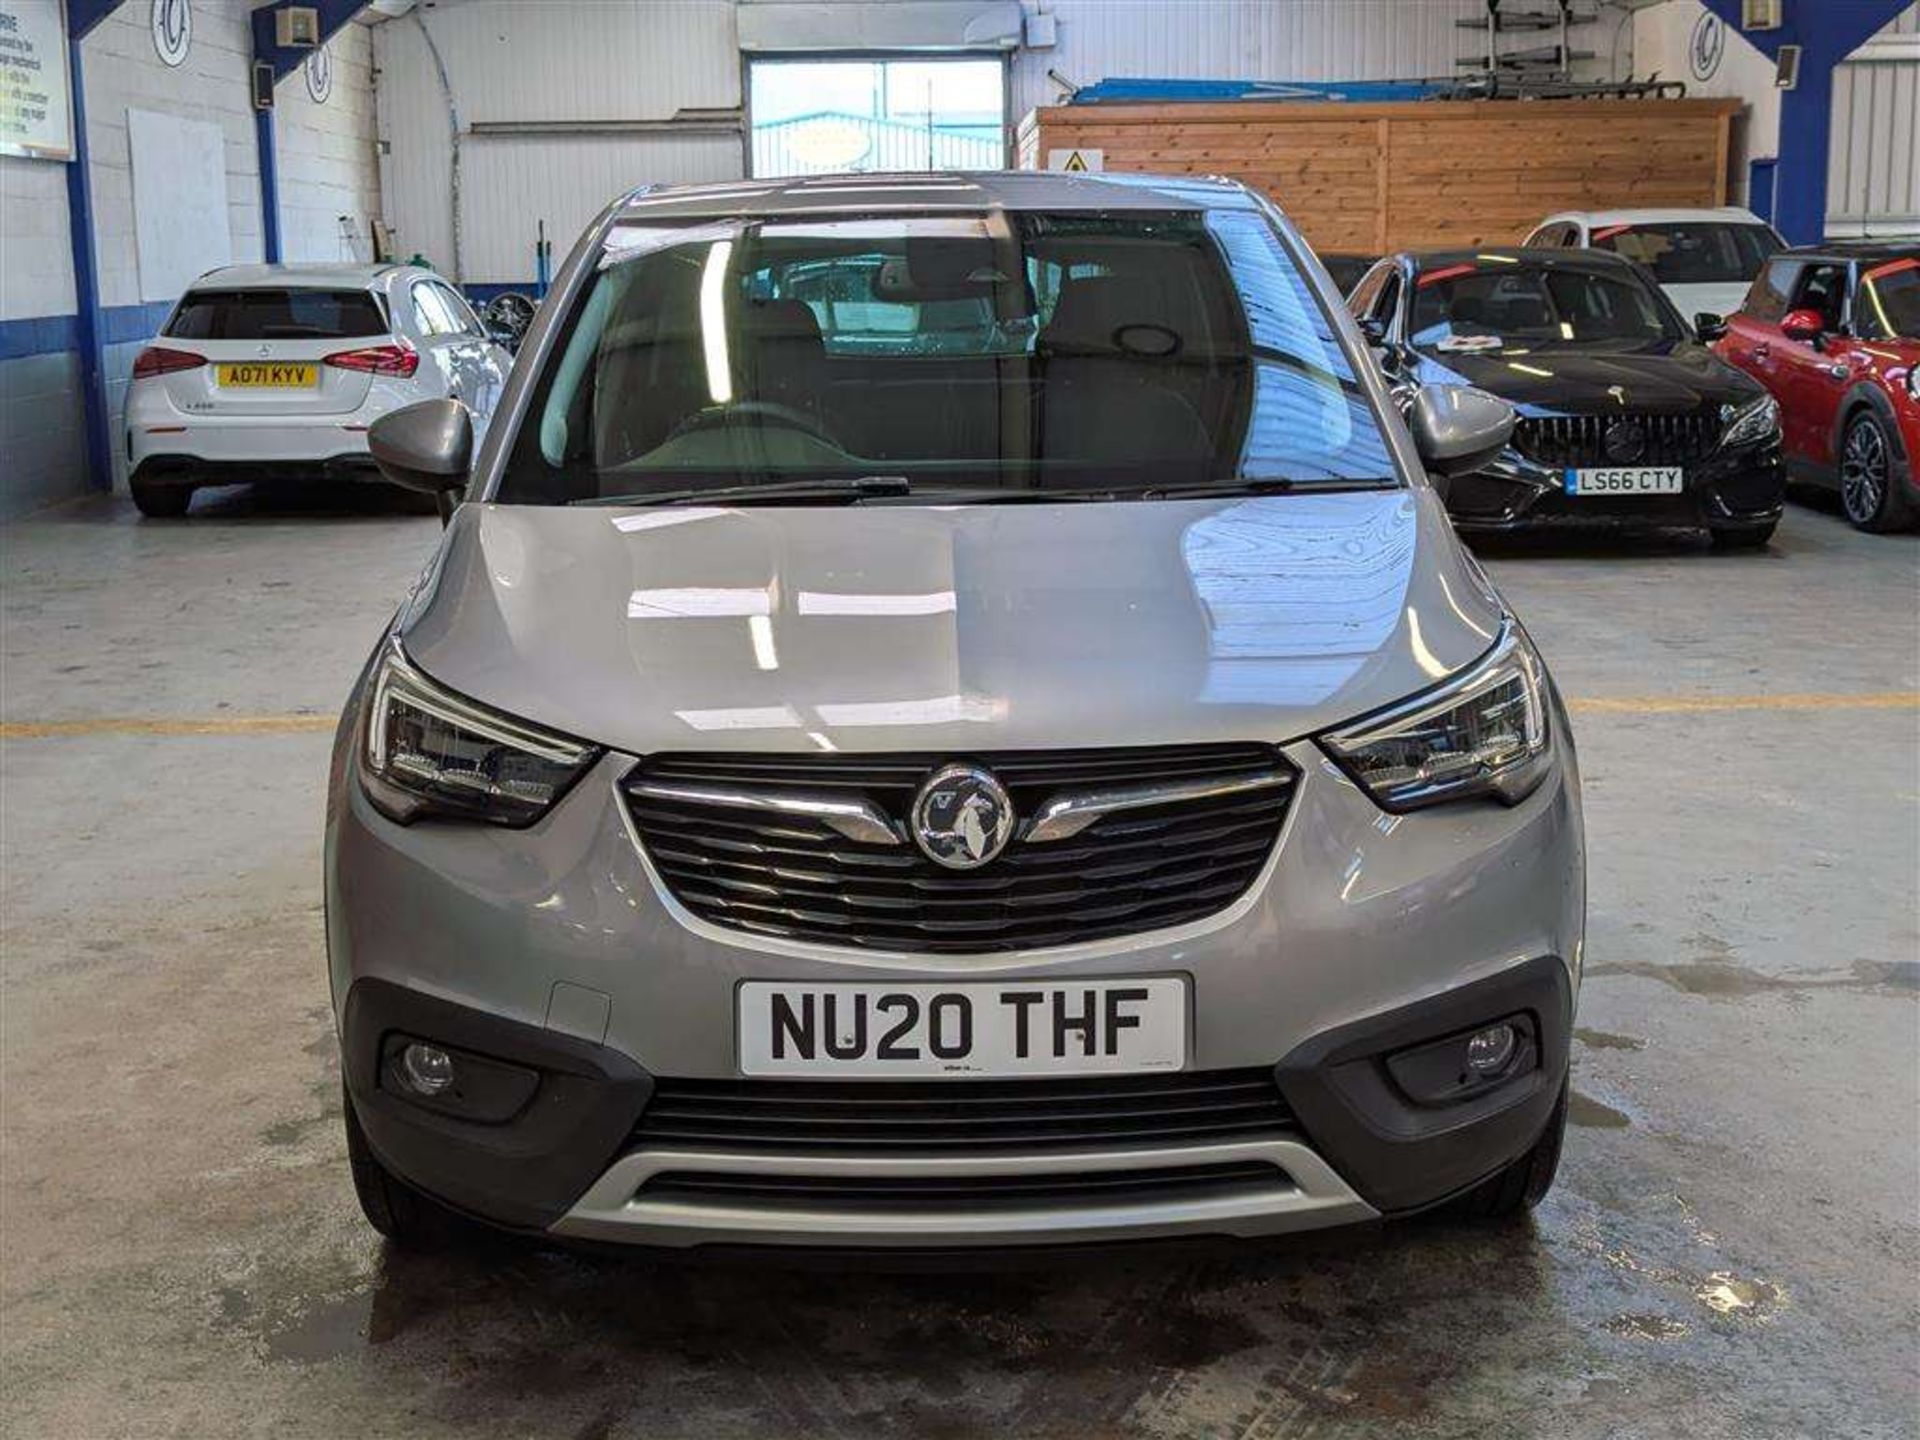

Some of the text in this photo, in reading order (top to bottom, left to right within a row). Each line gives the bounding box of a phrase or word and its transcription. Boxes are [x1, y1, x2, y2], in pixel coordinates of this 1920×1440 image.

[229, 367, 306, 383] AO71 KYV
[1581, 470, 1678, 490] LS66 CTY
[771, 988, 1148, 1060] NU20 THF
